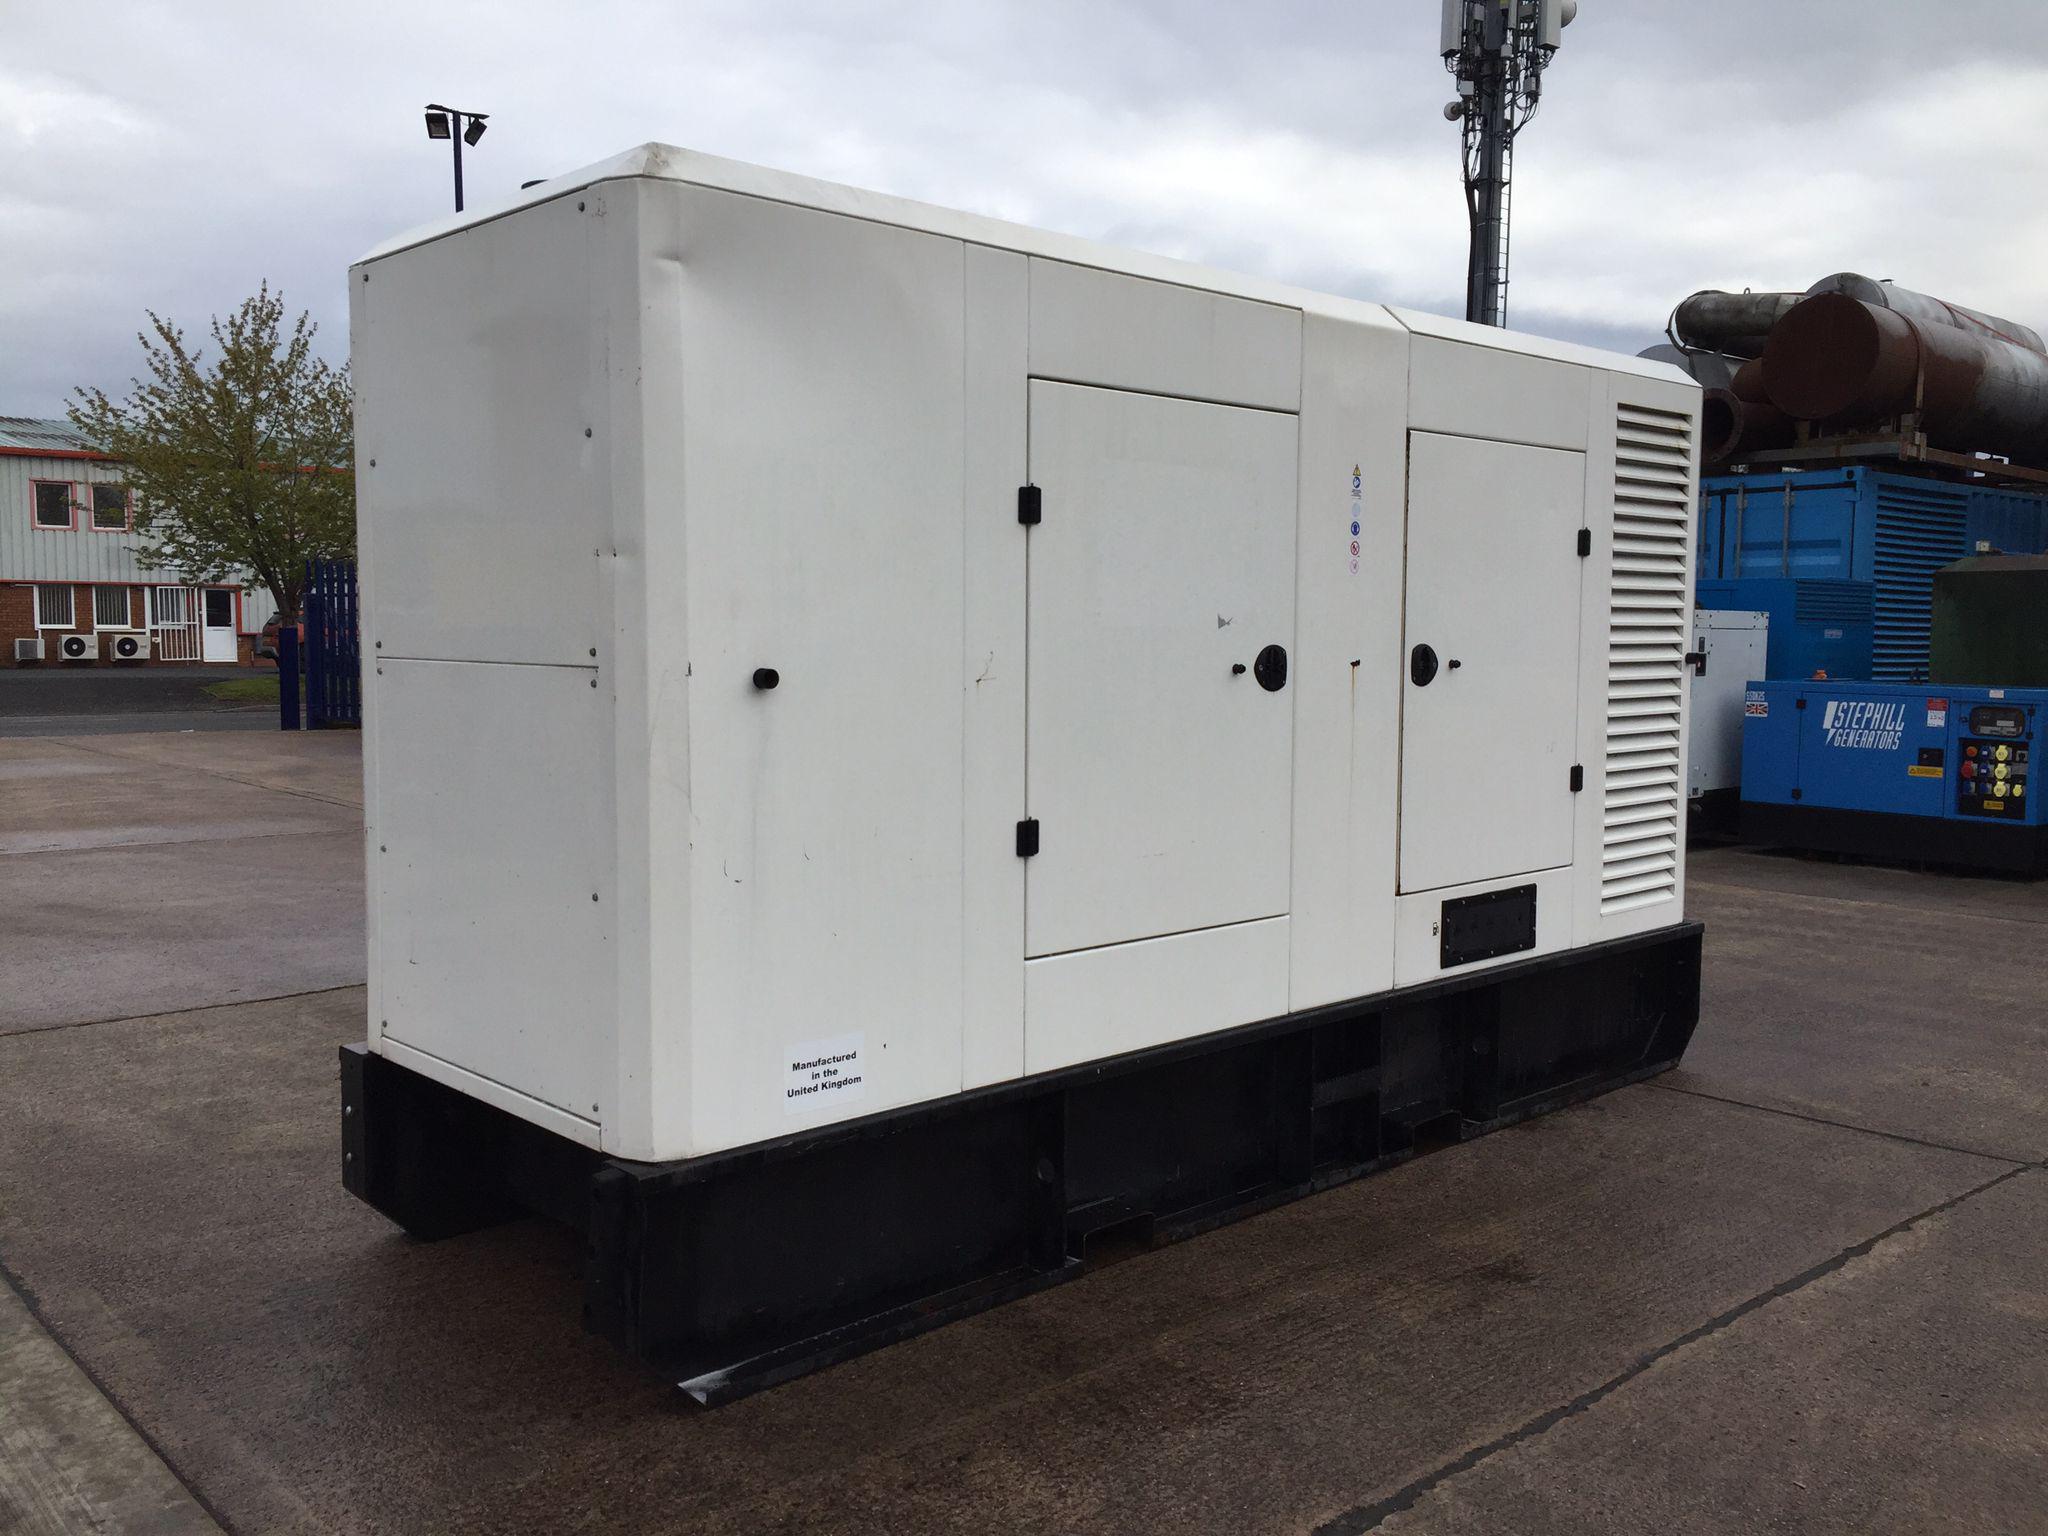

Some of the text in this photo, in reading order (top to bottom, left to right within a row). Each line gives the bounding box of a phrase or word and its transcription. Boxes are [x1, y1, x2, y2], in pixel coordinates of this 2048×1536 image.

[1834, 702, 1905, 730] STEPHILL
[1833, 728, 1902, 750] GENERATORS
[792, 1051, 857, 1071] Manufactured
[811, 1068, 838, 1080] in the
[787, 1076, 862, 1098] United Kingdom
